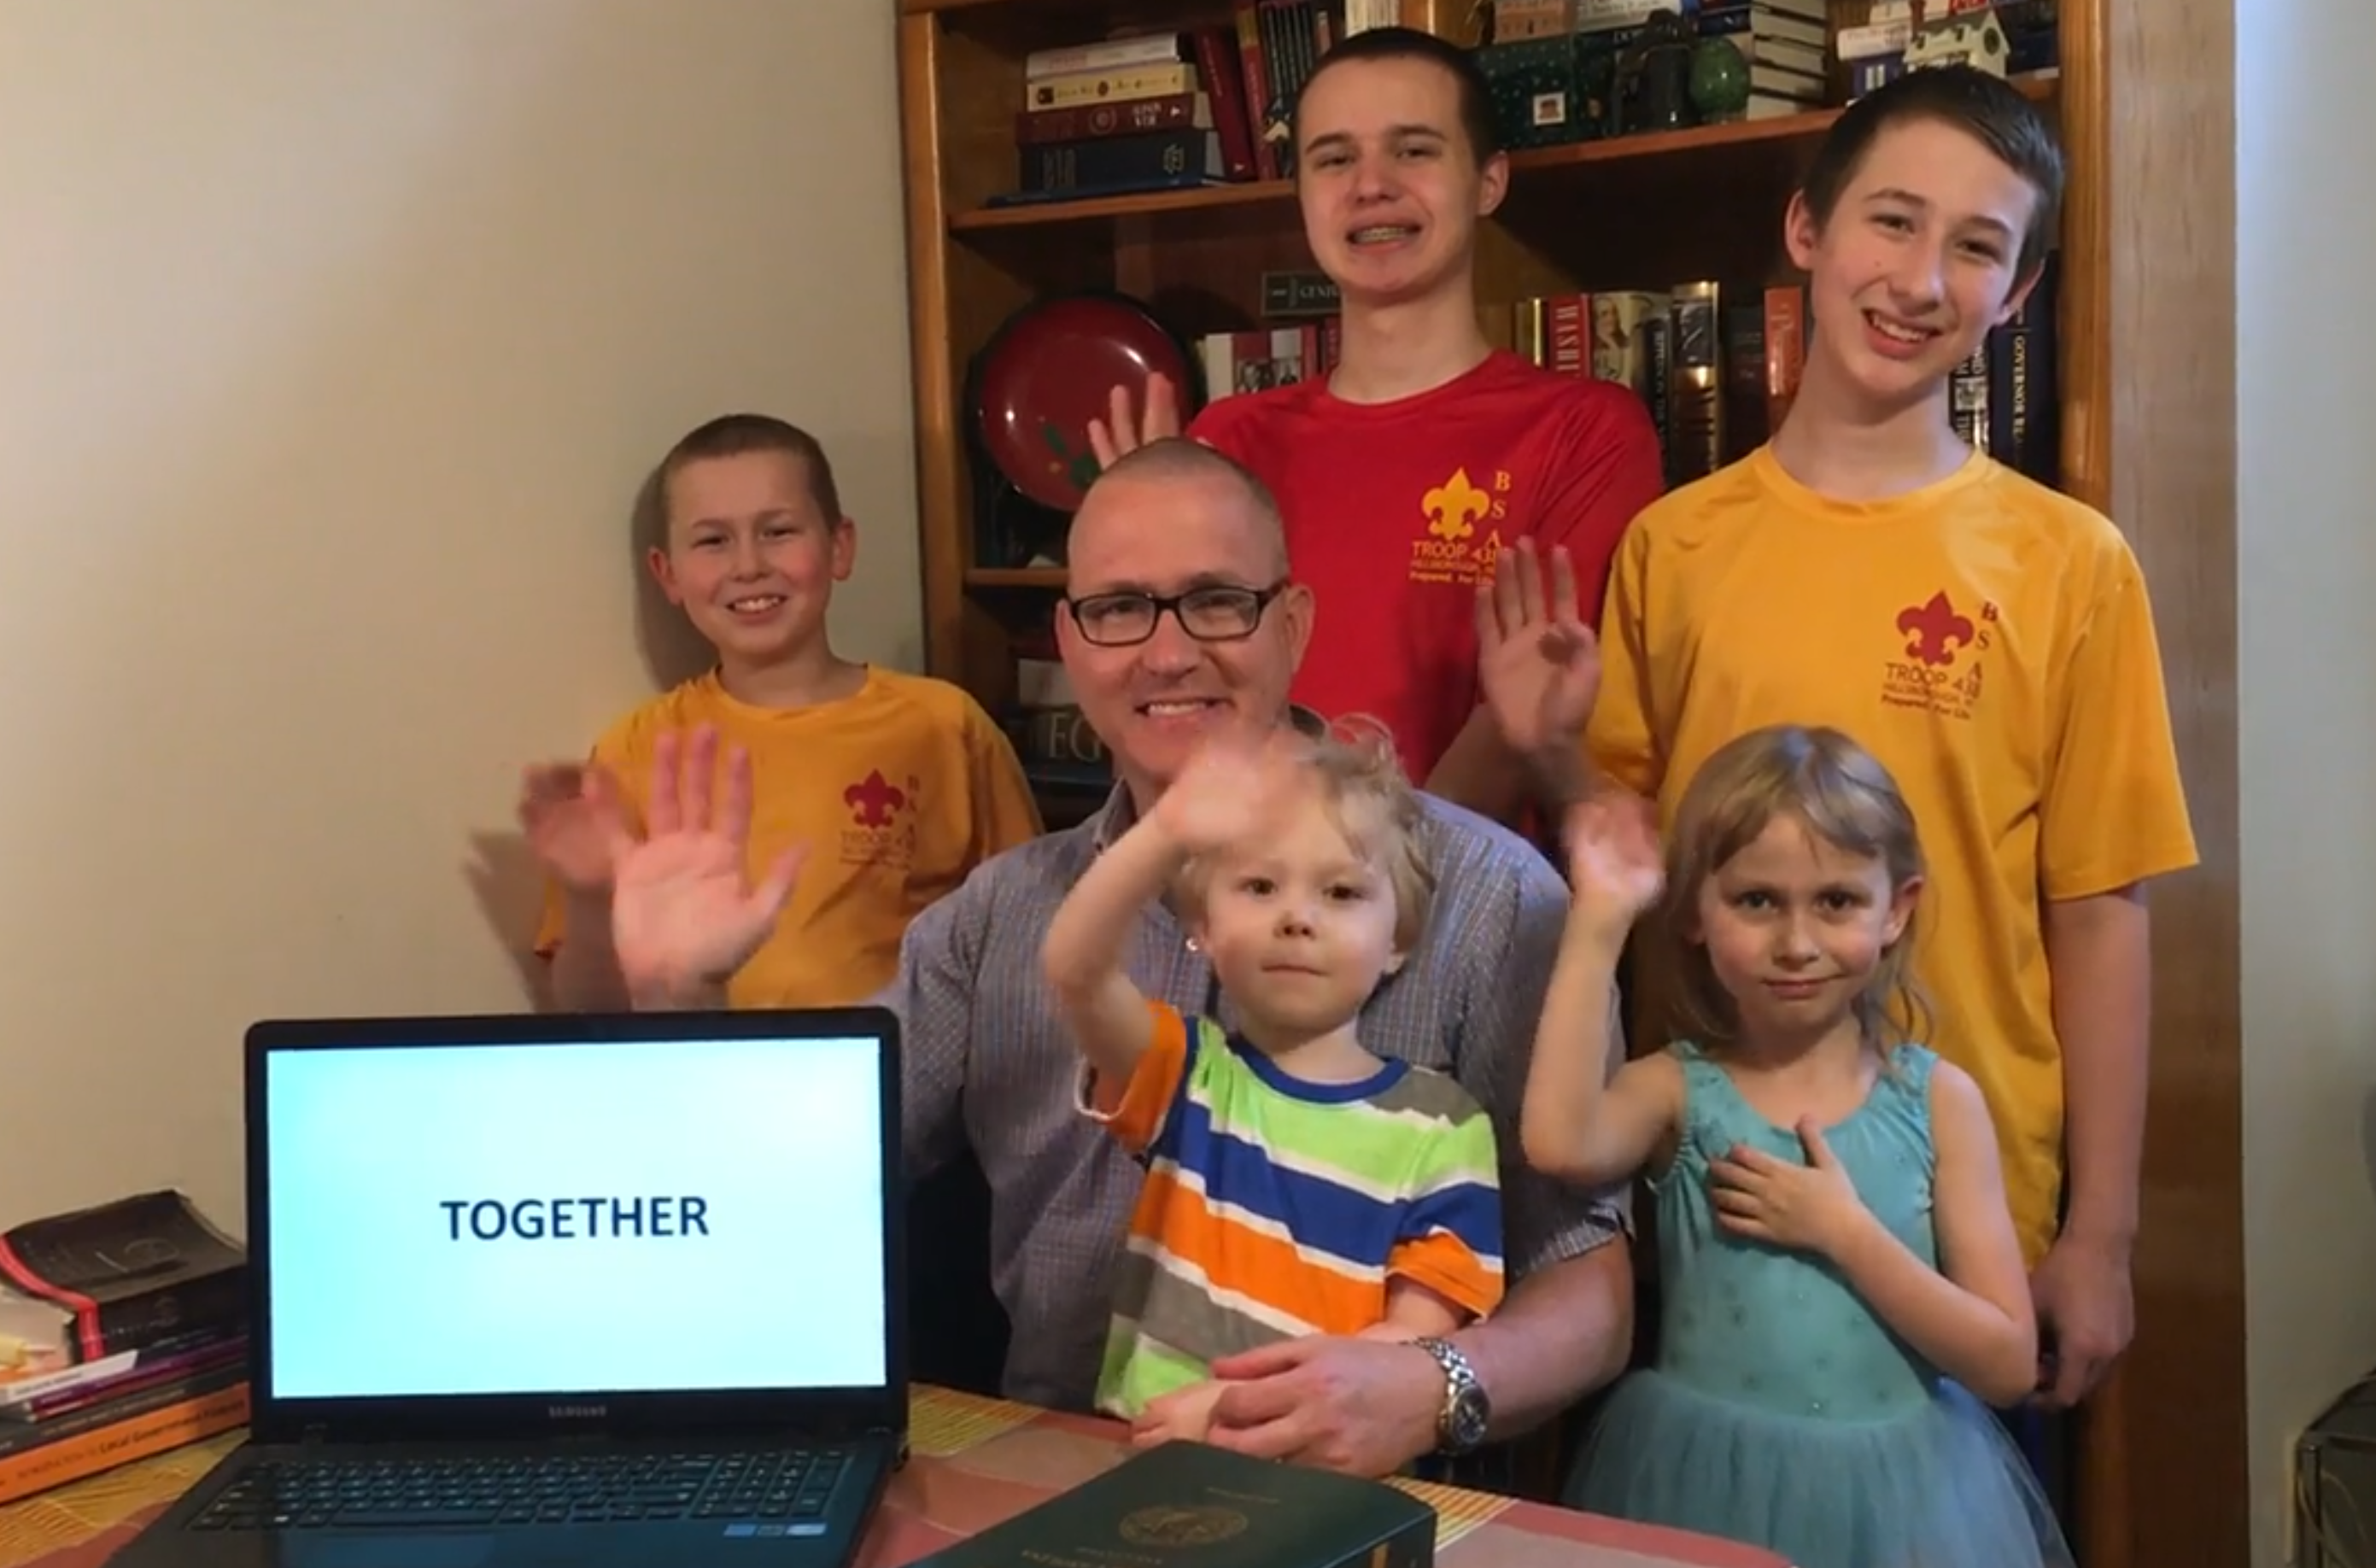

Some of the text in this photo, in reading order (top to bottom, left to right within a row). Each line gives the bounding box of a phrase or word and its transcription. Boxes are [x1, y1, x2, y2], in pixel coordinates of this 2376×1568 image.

[2013, 335, 2026, 413] GOVERNOR
[1412, 540, 1468, 559] TROOP
[1885, 662, 1948, 687] TROOP
[439, 1196, 710, 1241] TOGETHER
